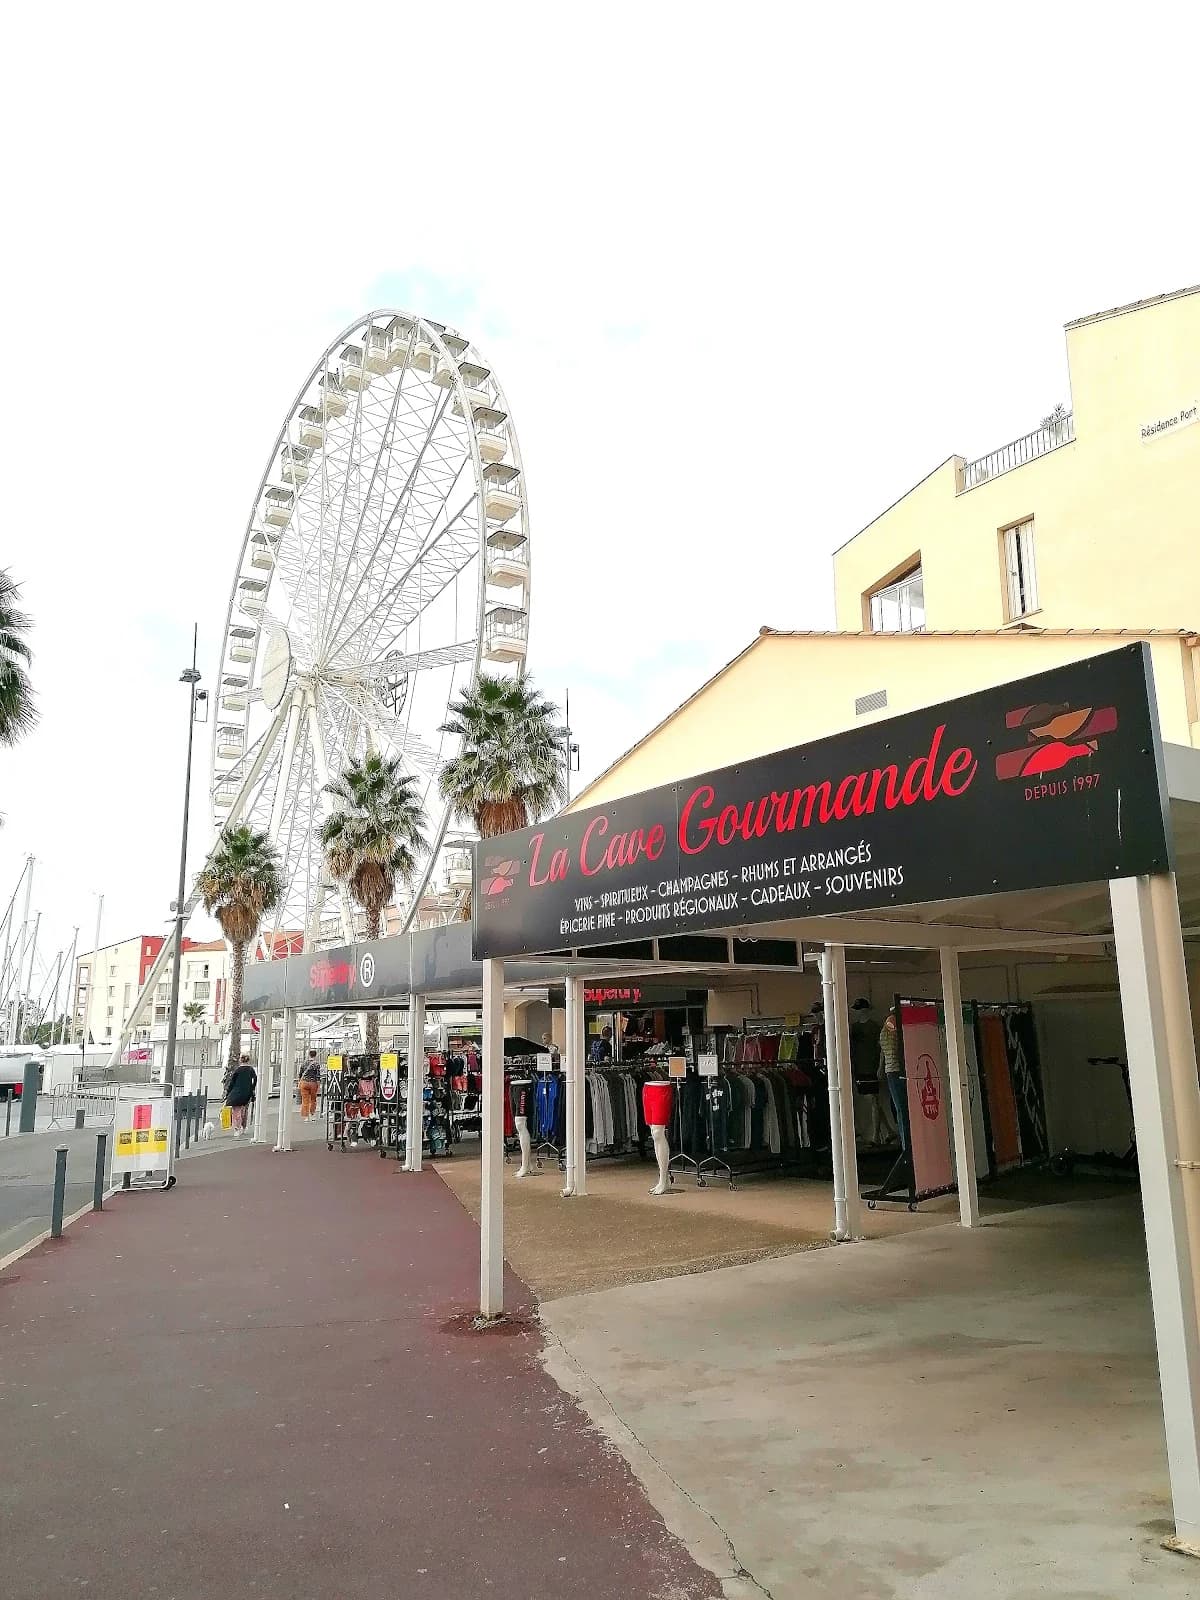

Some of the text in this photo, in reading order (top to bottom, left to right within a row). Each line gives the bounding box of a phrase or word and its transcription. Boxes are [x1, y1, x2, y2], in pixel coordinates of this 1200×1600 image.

[1180, 406, 1197, 421] Port
[528, 724, 978, 887] La Cave Gourmande
[1024, 773, 1100, 801] DEPUIS 1997
[560, 915, 595, 935] ÉPICERIE
[597, 912, 616, 929] FINE
[625, 903, 671, 925] PRODUITS
[673, 892, 739, 917] RÉGIONAUX
[751, 880, 811, 906] CADEAUX
[825, 865, 904, 896] SOUVENIRS
[574, 895, 593, 912] VINS
[600, 885, 649, 908] SPIRITUEUX
[658, 869, 729, 897] CHAMPAGNES
[741, 860, 779, 883] RHUMS
[783, 857, 797, 876] ET
[800, 839, 872, 873] ARRANGÉS
